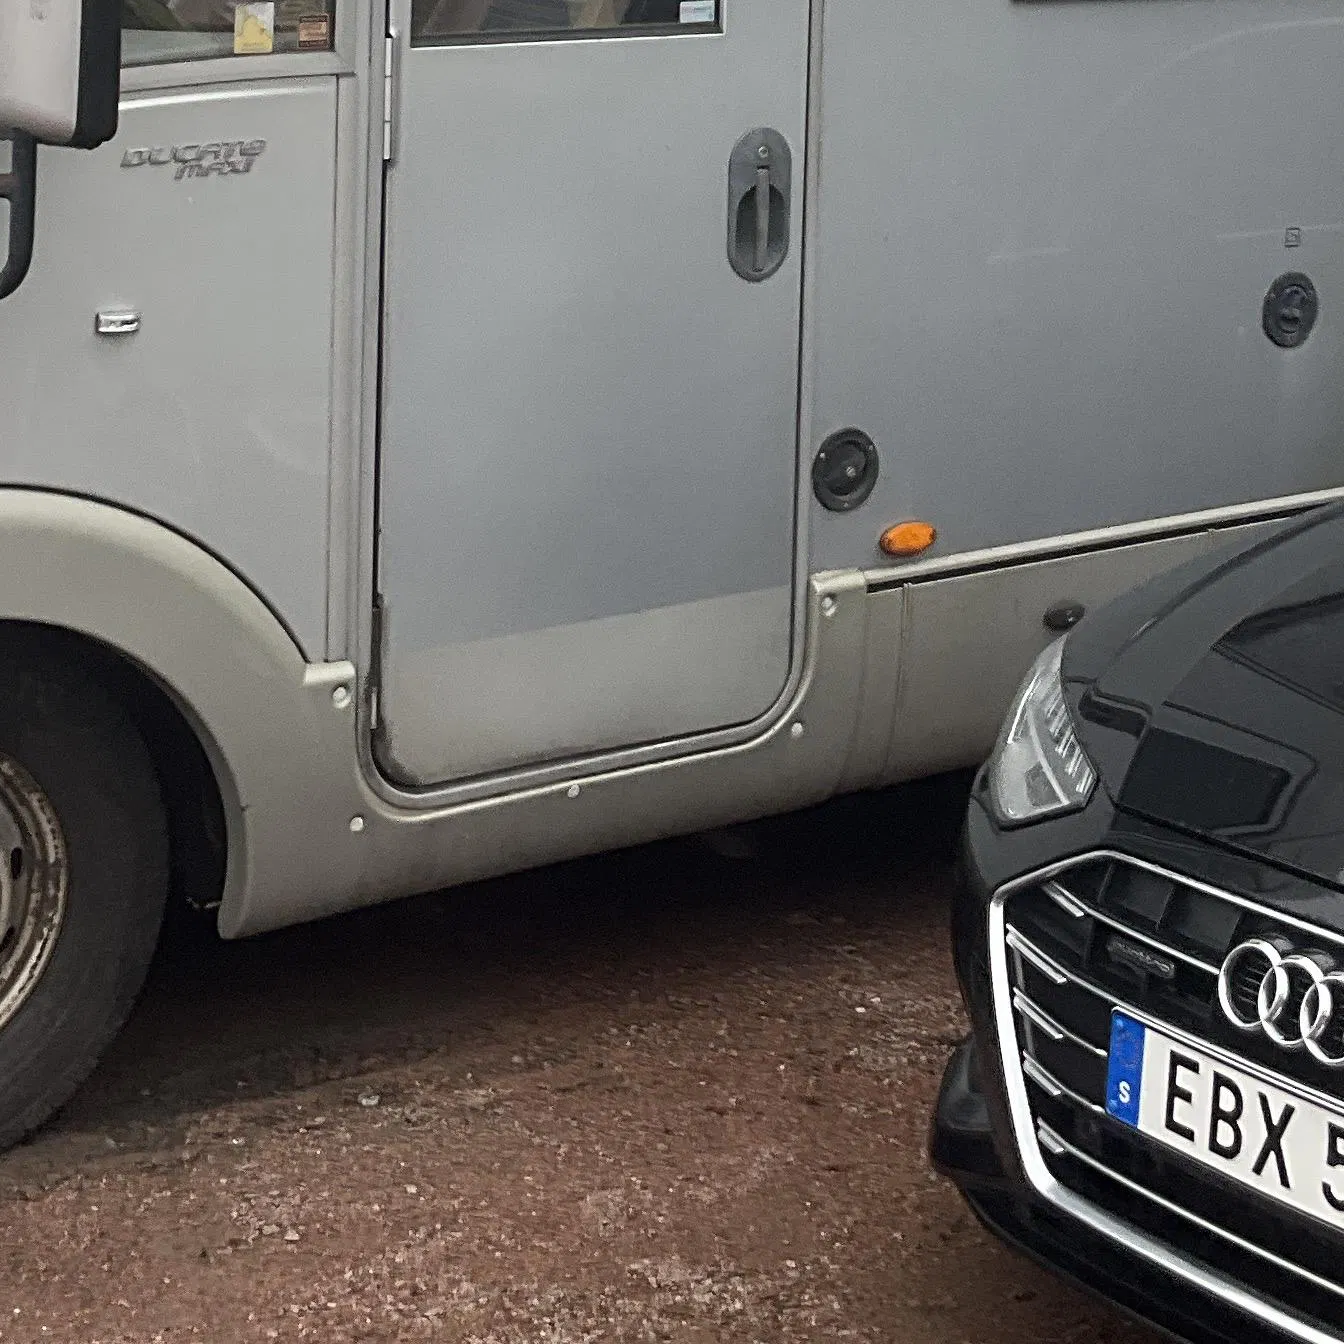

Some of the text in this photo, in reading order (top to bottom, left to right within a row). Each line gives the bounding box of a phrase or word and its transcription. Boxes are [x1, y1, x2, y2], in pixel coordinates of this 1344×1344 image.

[120, 139, 267, 168] DUCATO
[1117, 1080, 1131, 1104] S
[1164, 1049, 1296, 1190] EBX
